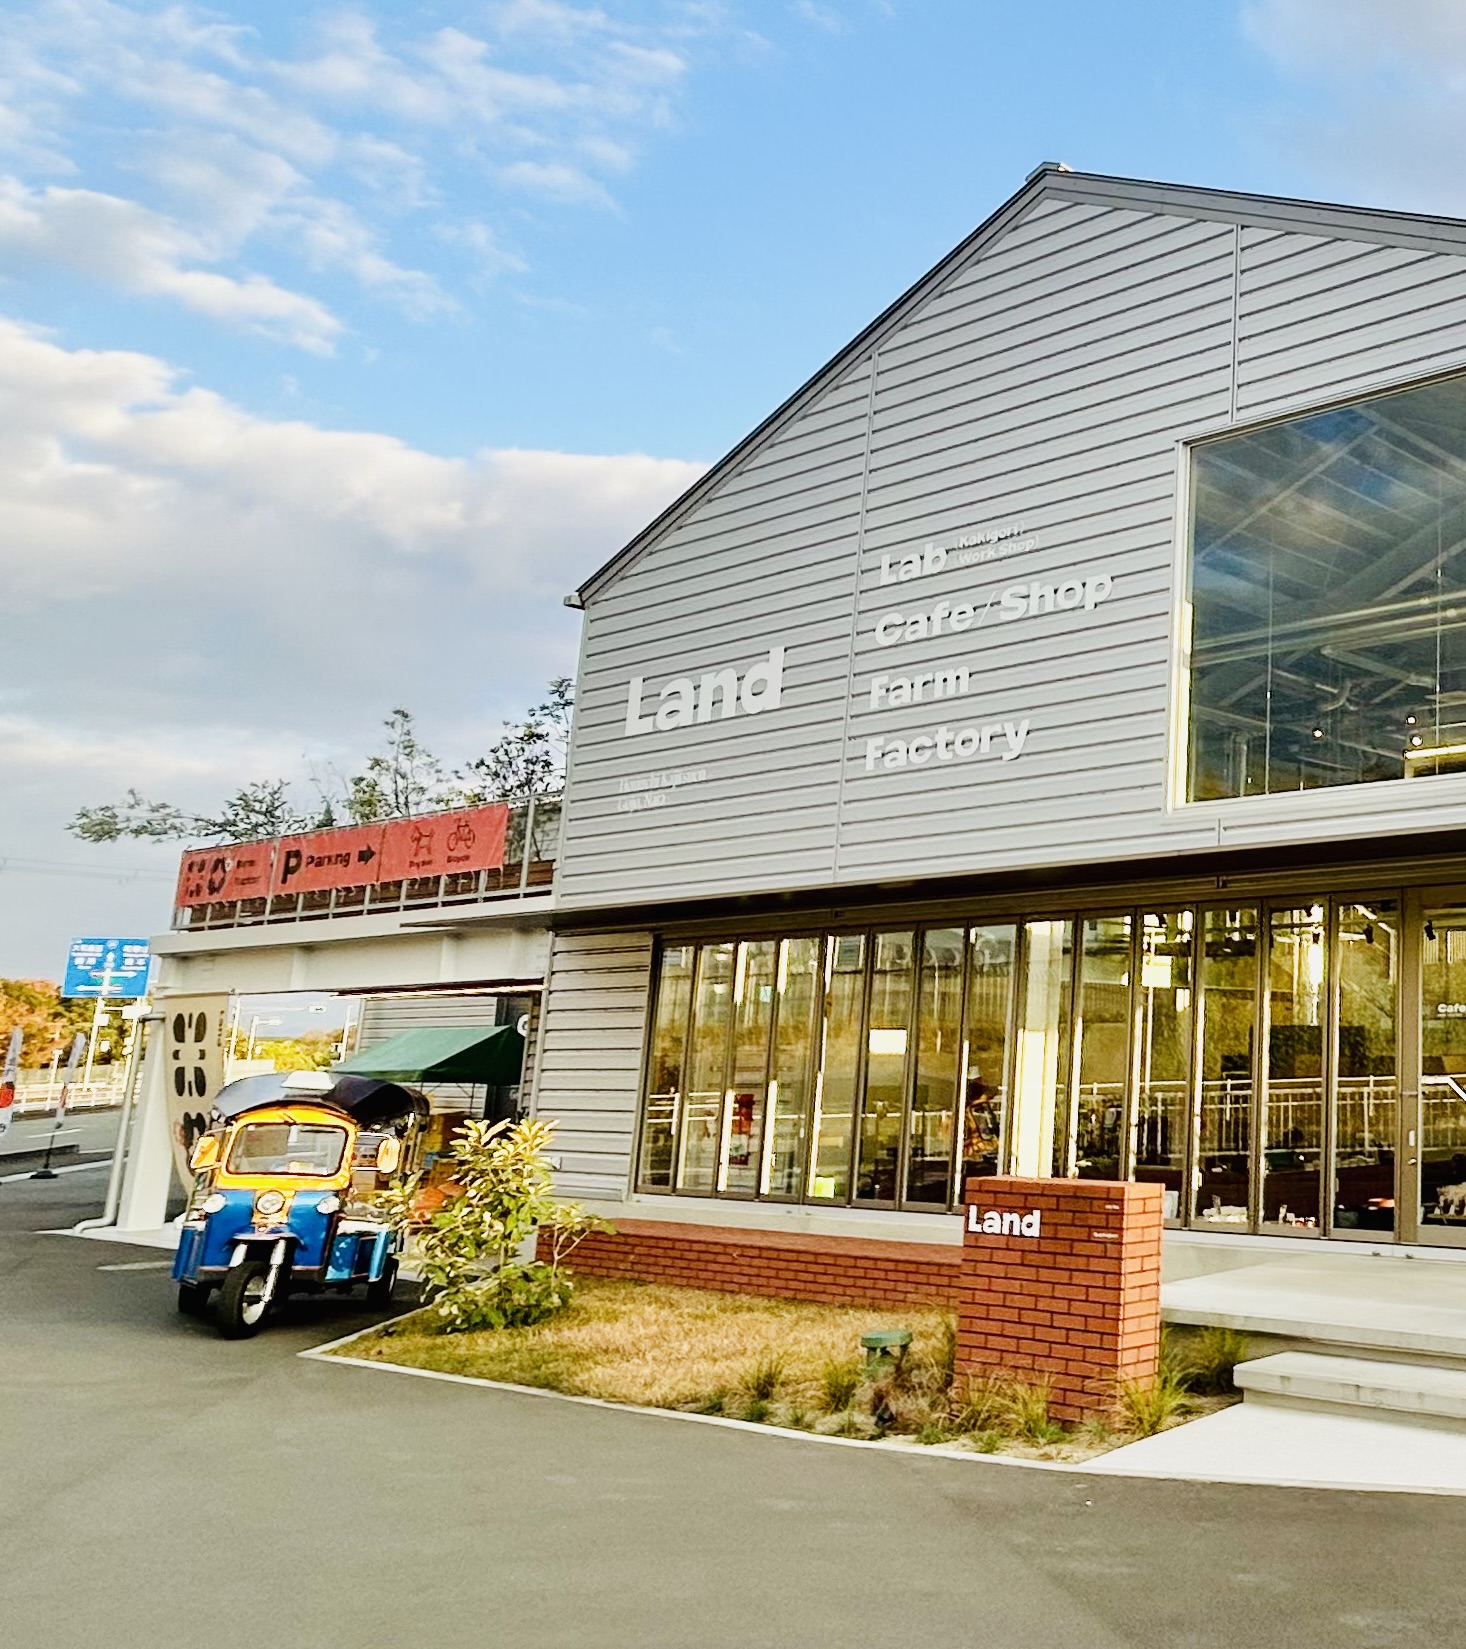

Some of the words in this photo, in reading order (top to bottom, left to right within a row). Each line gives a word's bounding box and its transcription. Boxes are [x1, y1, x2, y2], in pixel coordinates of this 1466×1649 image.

[880, 542, 948, 586] Lab
[624, 645, 786, 737] Land
[870, 665, 970, 709] Farm
[865, 719, 1030, 771] Factory
[967, 1204, 1042, 1238] Land
